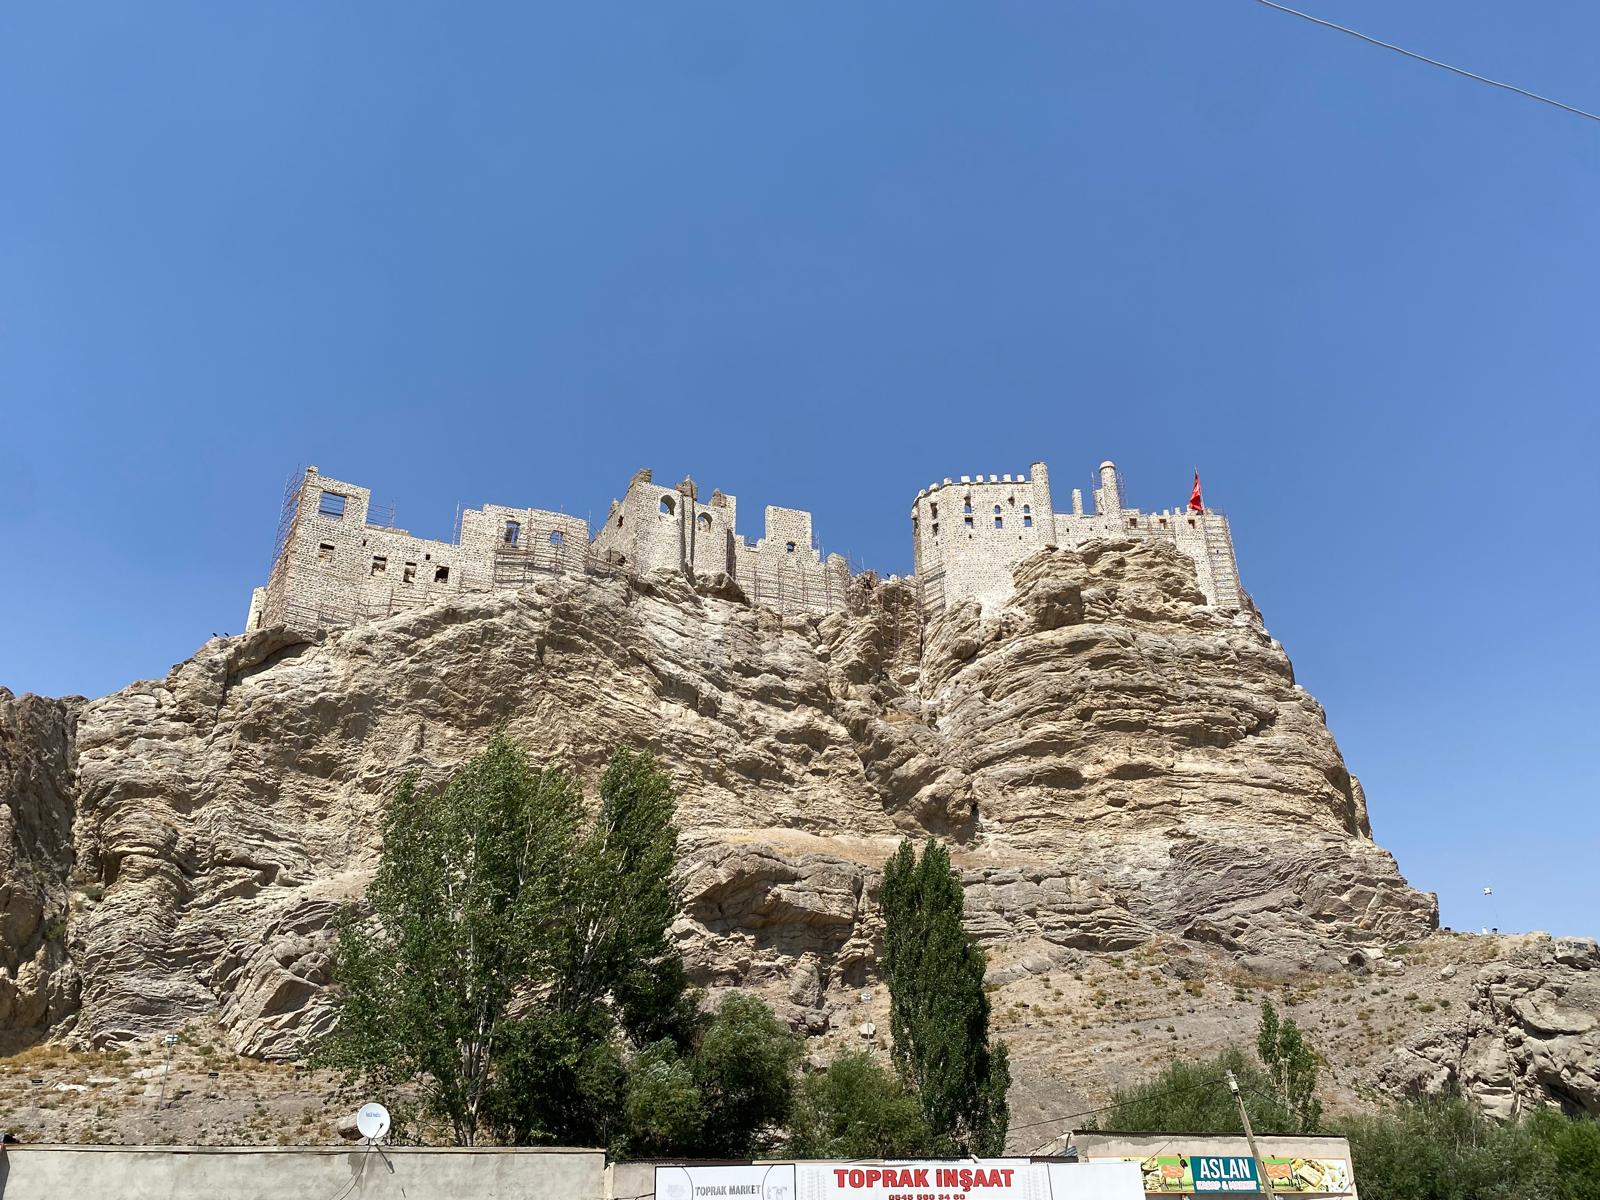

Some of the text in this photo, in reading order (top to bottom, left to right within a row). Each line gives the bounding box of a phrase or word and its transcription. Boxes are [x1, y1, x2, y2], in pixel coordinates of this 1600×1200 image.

[834, 1169, 929, 1188] TOPRAK
[1200, 1159, 1251, 1179] ASLAN
[694, 1184, 761, 1196] TOPRAK MARKET
